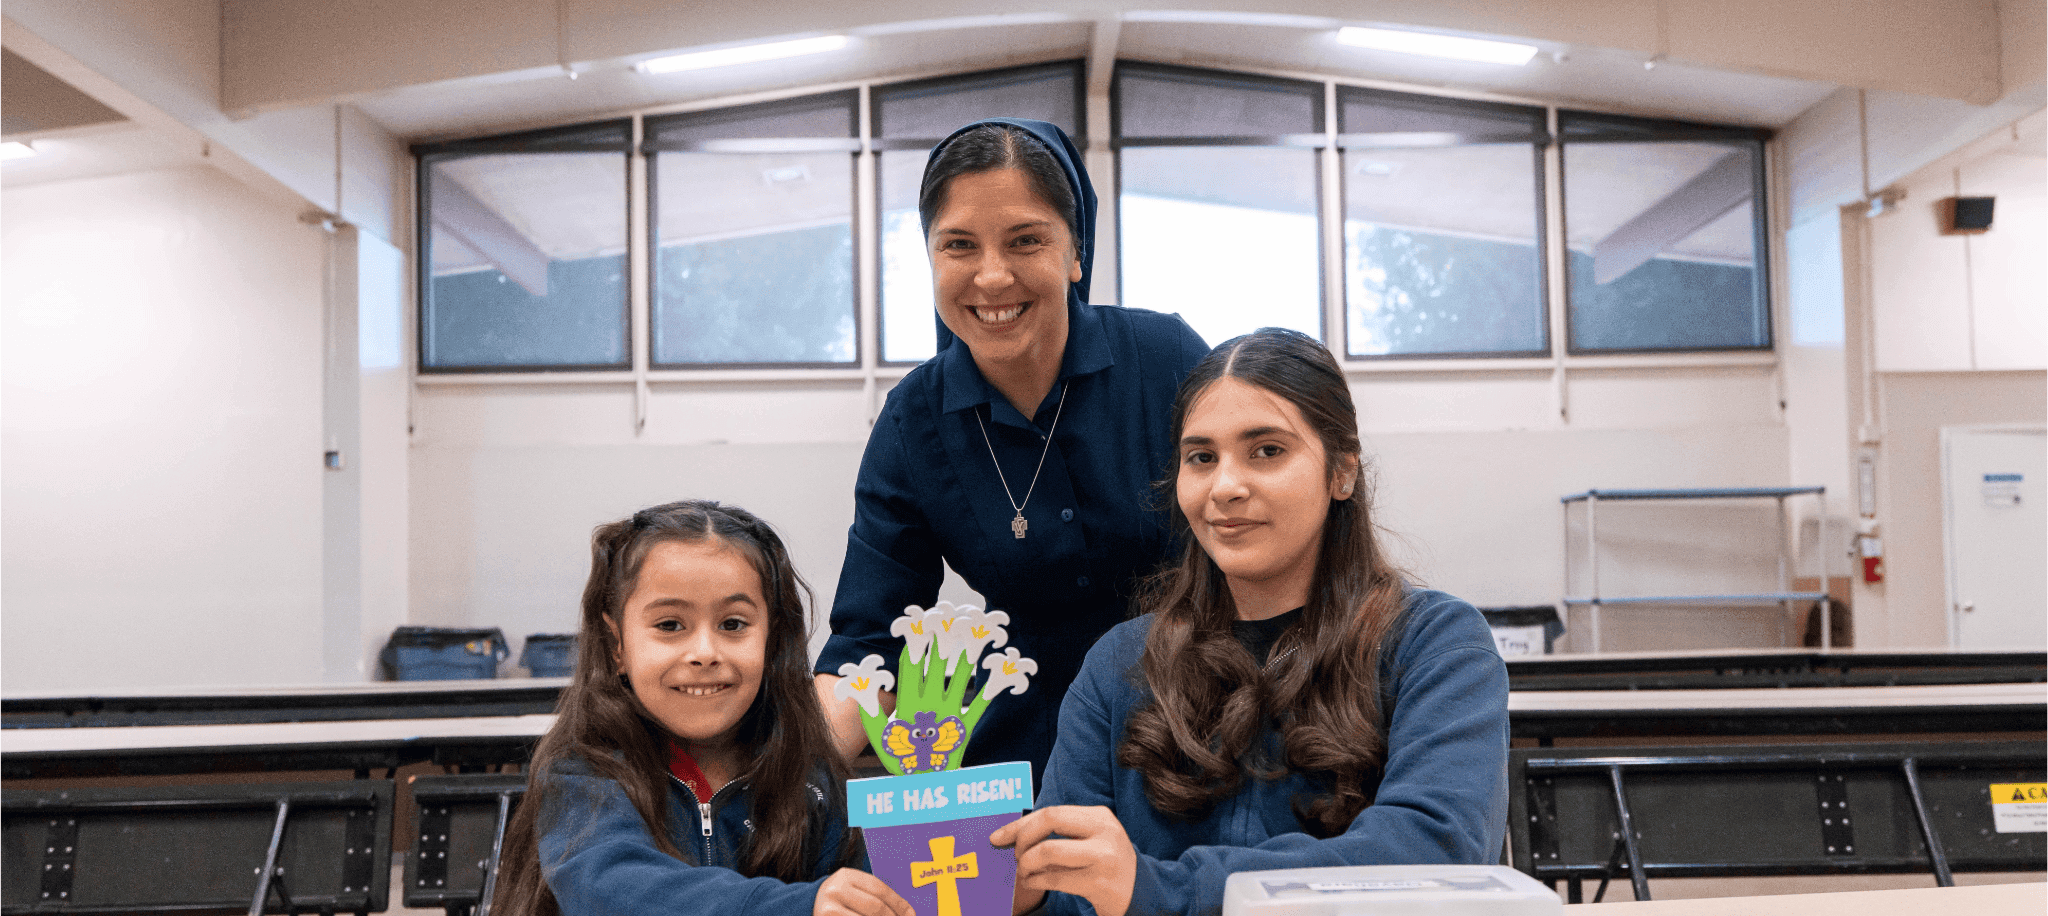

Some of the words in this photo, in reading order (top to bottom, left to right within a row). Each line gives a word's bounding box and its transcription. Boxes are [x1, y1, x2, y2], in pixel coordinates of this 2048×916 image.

[866, 791, 895, 815] HE
[903, 786, 949, 811] HAS
[956, 778, 1023, 805] RISEN!
[919, 865, 944, 879] John
[947, 863, 970, 875] 11:25
